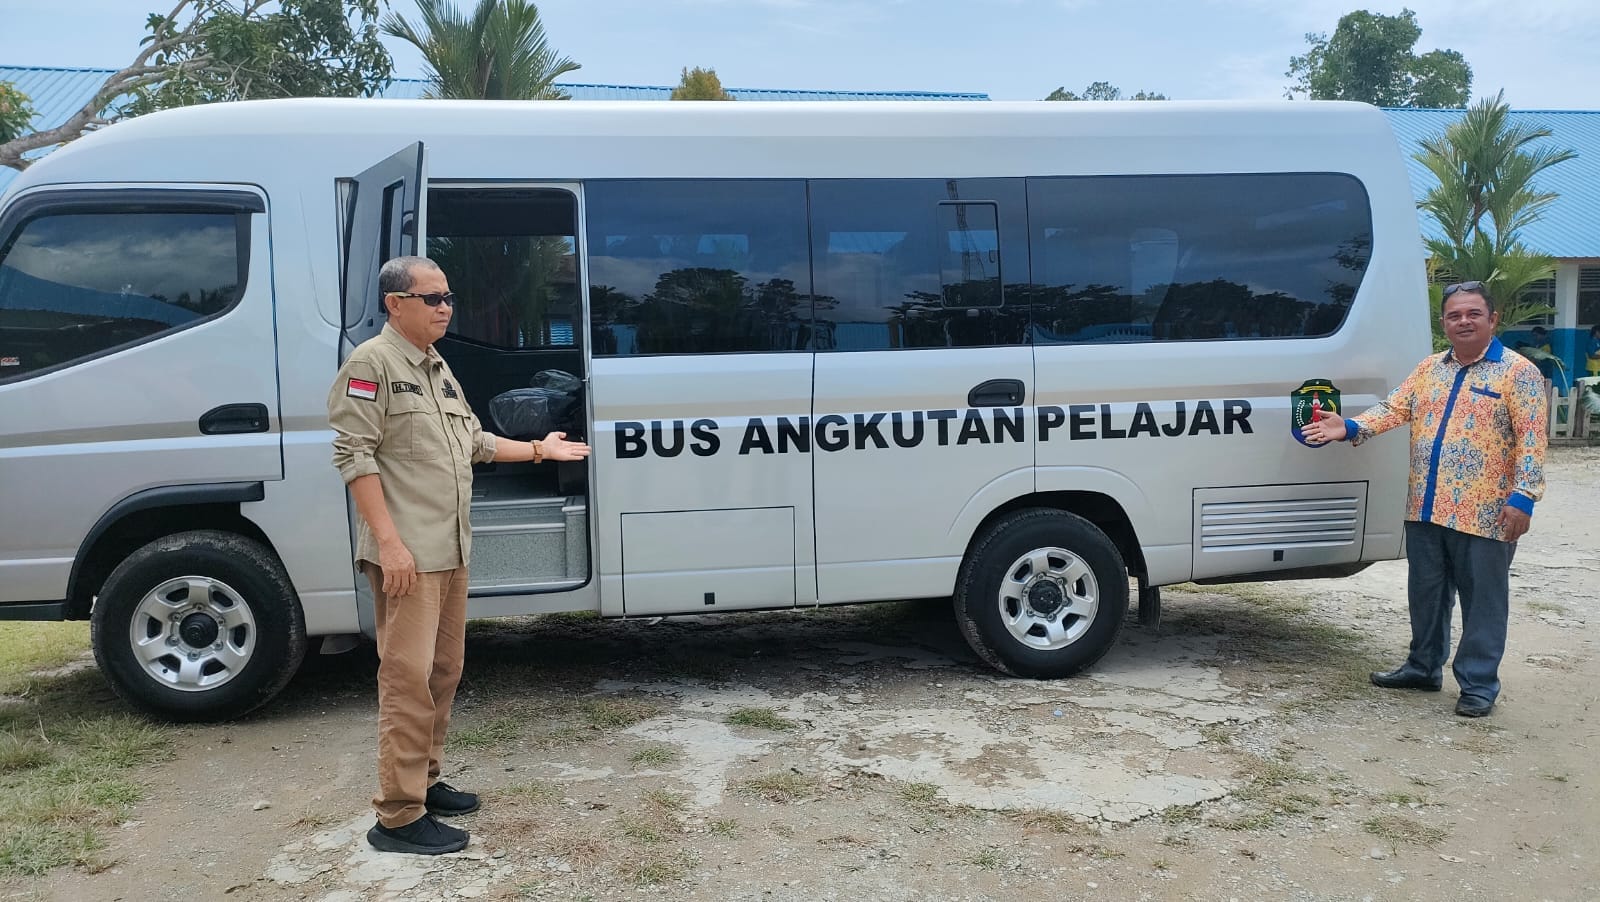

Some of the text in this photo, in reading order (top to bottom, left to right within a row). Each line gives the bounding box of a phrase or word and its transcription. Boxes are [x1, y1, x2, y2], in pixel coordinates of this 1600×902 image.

[615, 400, 1254, 458] BUS ANGKUTAN PELAJAR
